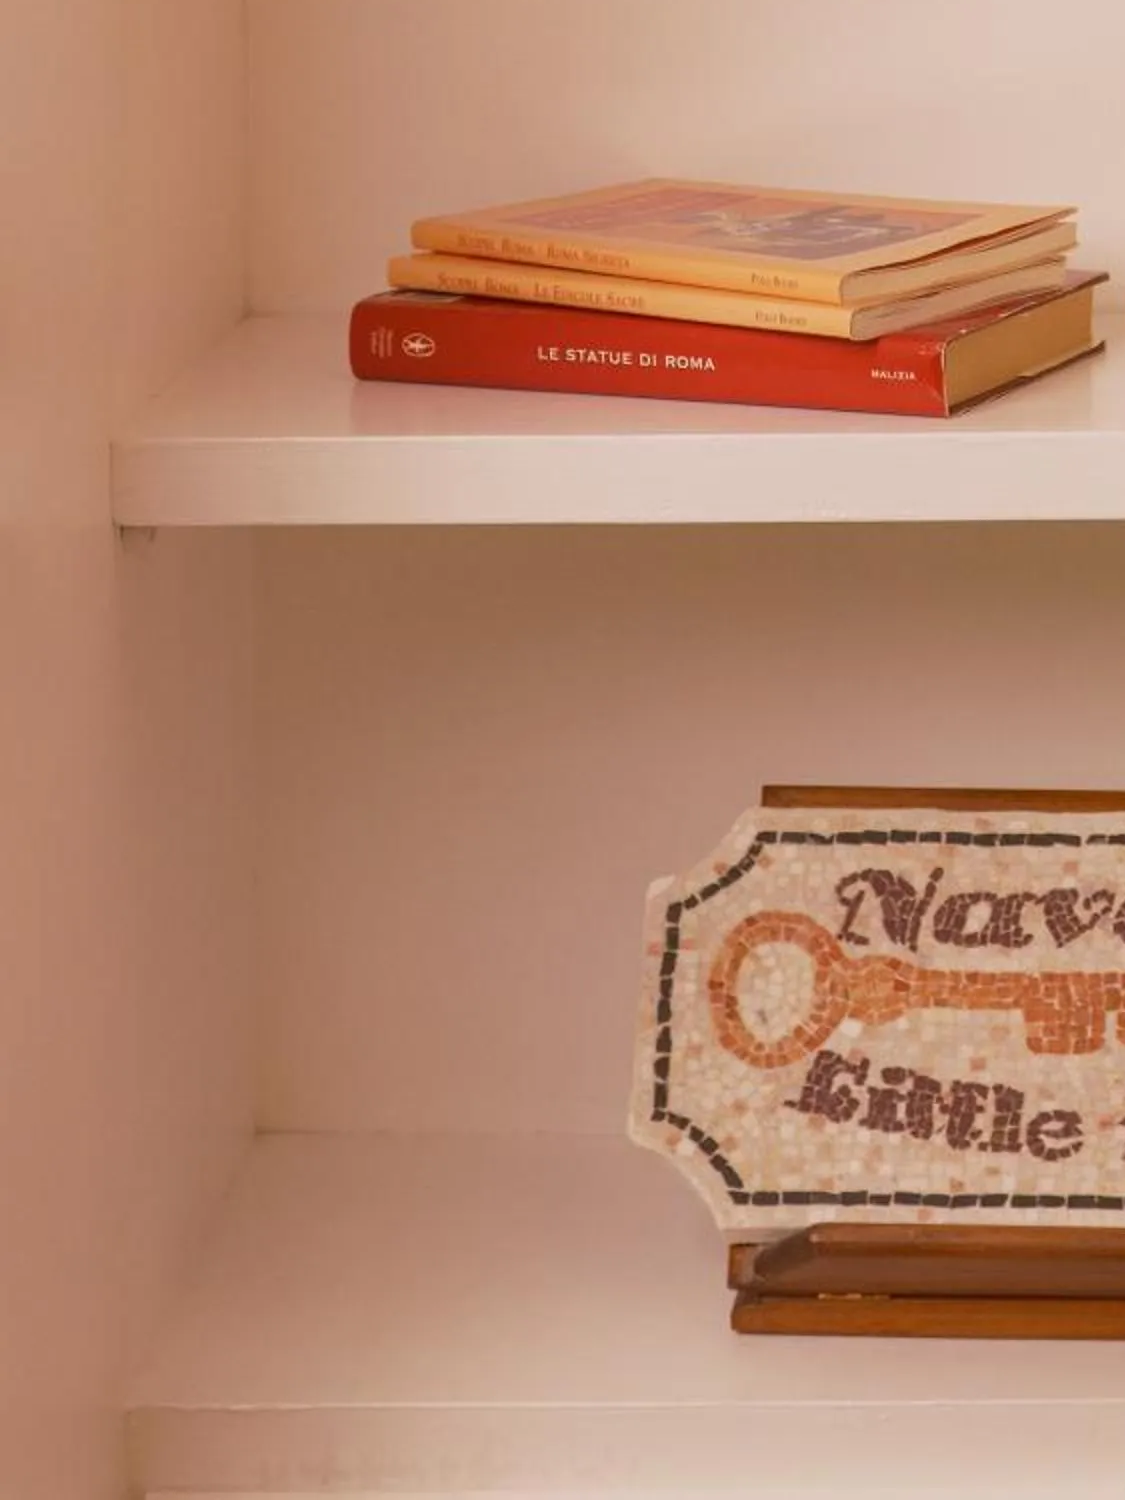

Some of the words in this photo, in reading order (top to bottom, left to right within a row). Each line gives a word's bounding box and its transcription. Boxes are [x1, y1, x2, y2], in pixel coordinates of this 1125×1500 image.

[537, 346, 558, 361] LE
[565, 349, 632, 366] STATUE
[639, 353, 657, 367] DI
[665, 355, 715, 372] ROMA
